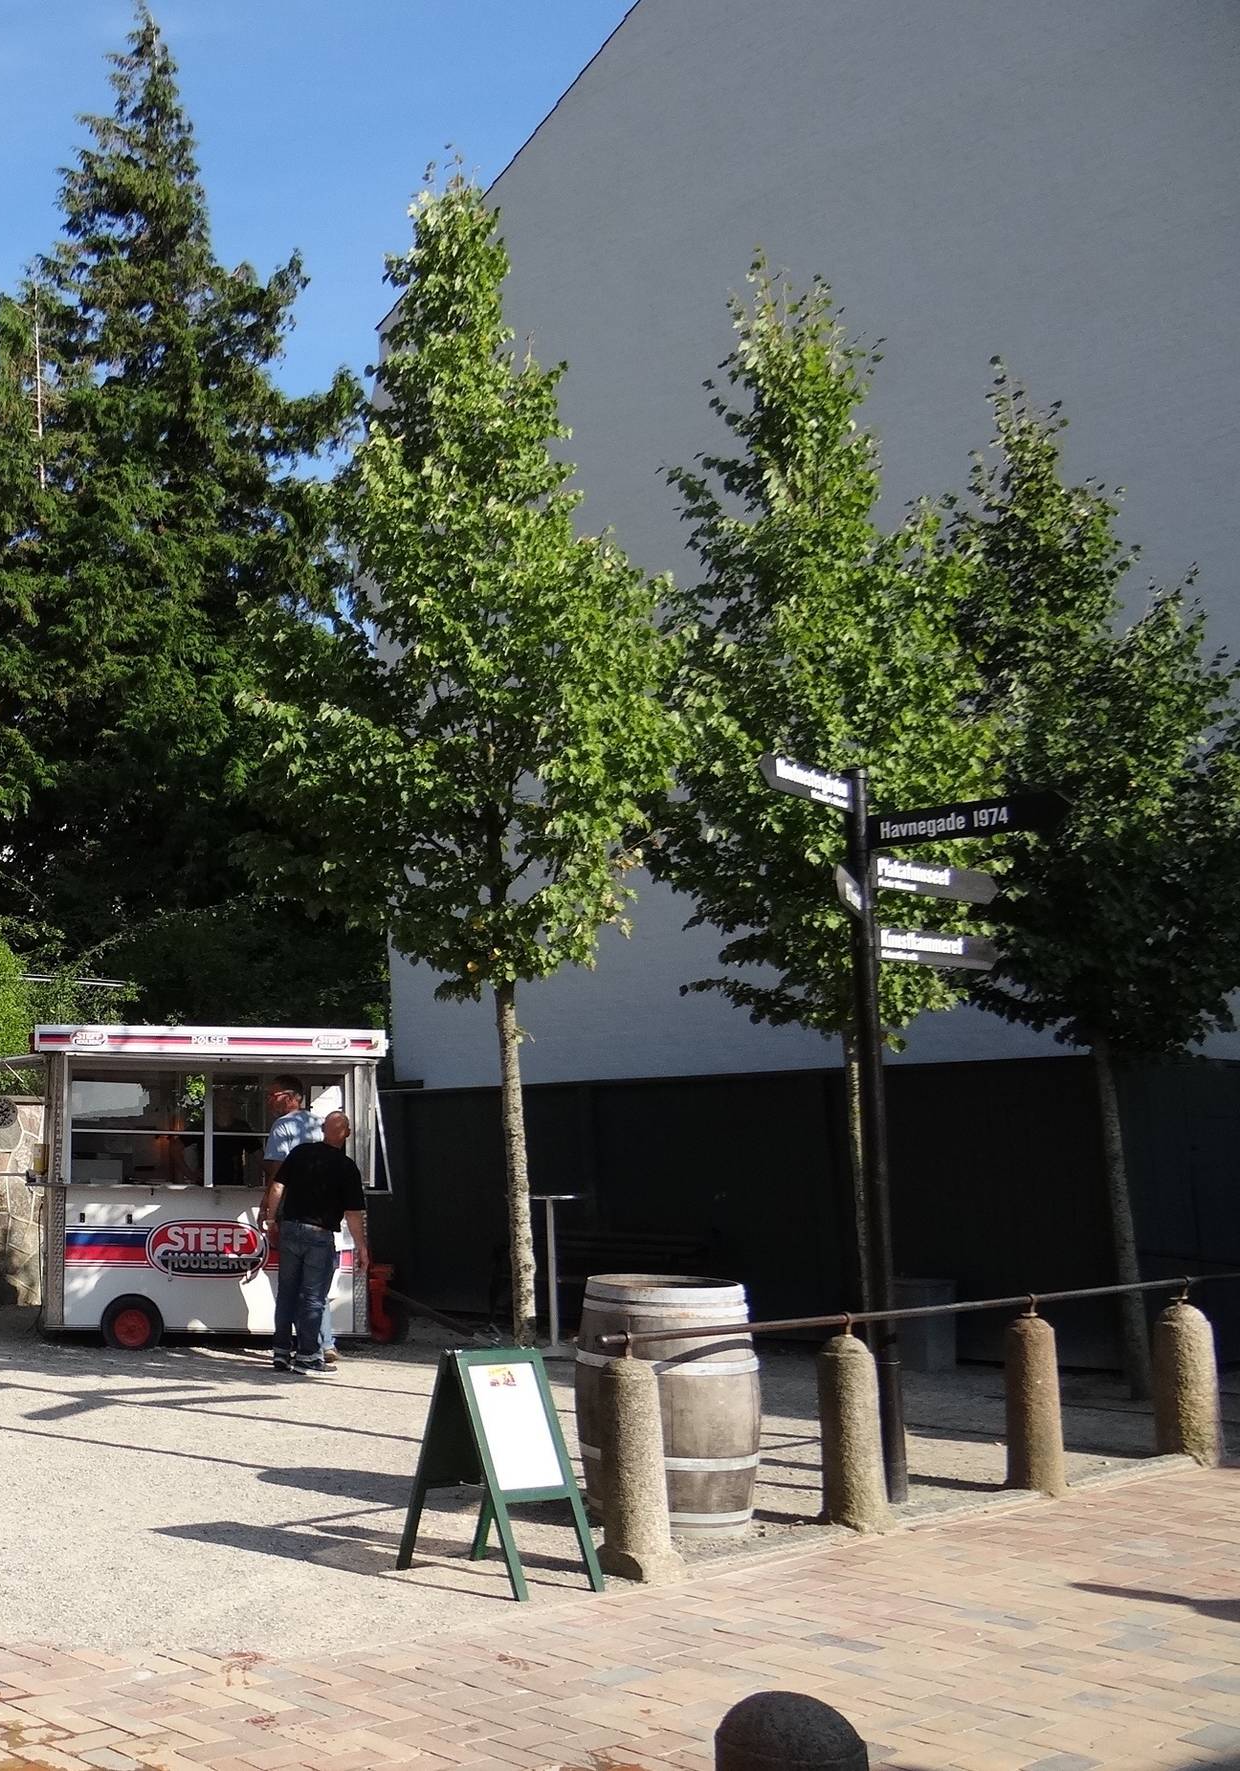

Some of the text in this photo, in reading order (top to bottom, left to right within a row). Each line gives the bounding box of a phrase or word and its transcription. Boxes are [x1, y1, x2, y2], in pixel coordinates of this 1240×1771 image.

[880, 806, 1009, 839] Havnegade 1974
[162, 1226, 248, 1252] STEFF
